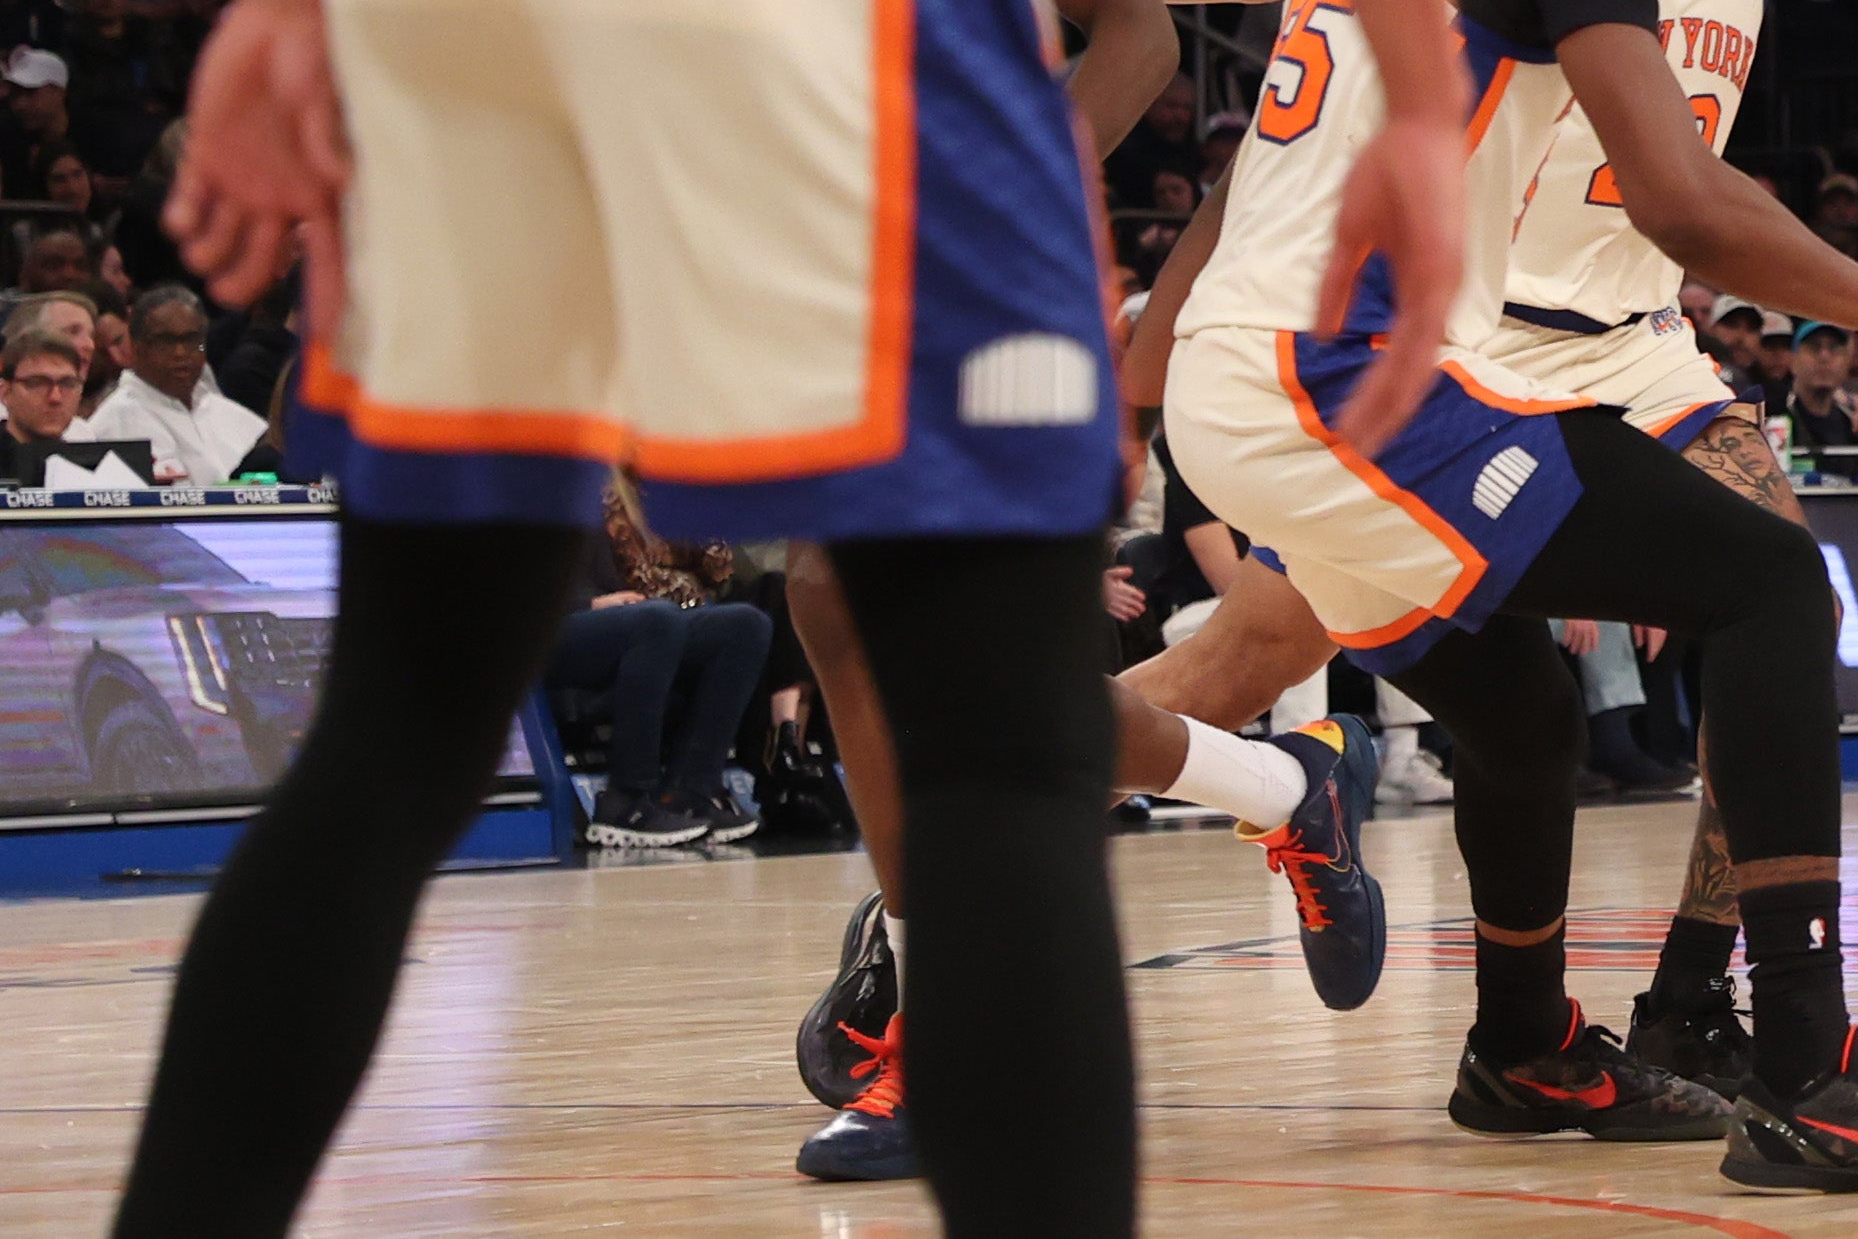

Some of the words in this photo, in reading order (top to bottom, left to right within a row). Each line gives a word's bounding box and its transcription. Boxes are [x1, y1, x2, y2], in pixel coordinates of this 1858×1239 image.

[6, 491, 54, 507] CHASE
[84, 489, 130, 507] CHASE
[160, 489, 205, 506] CHASE
[234, 489, 280, 505] CHASE
[307, 488, 338, 504] CHA
